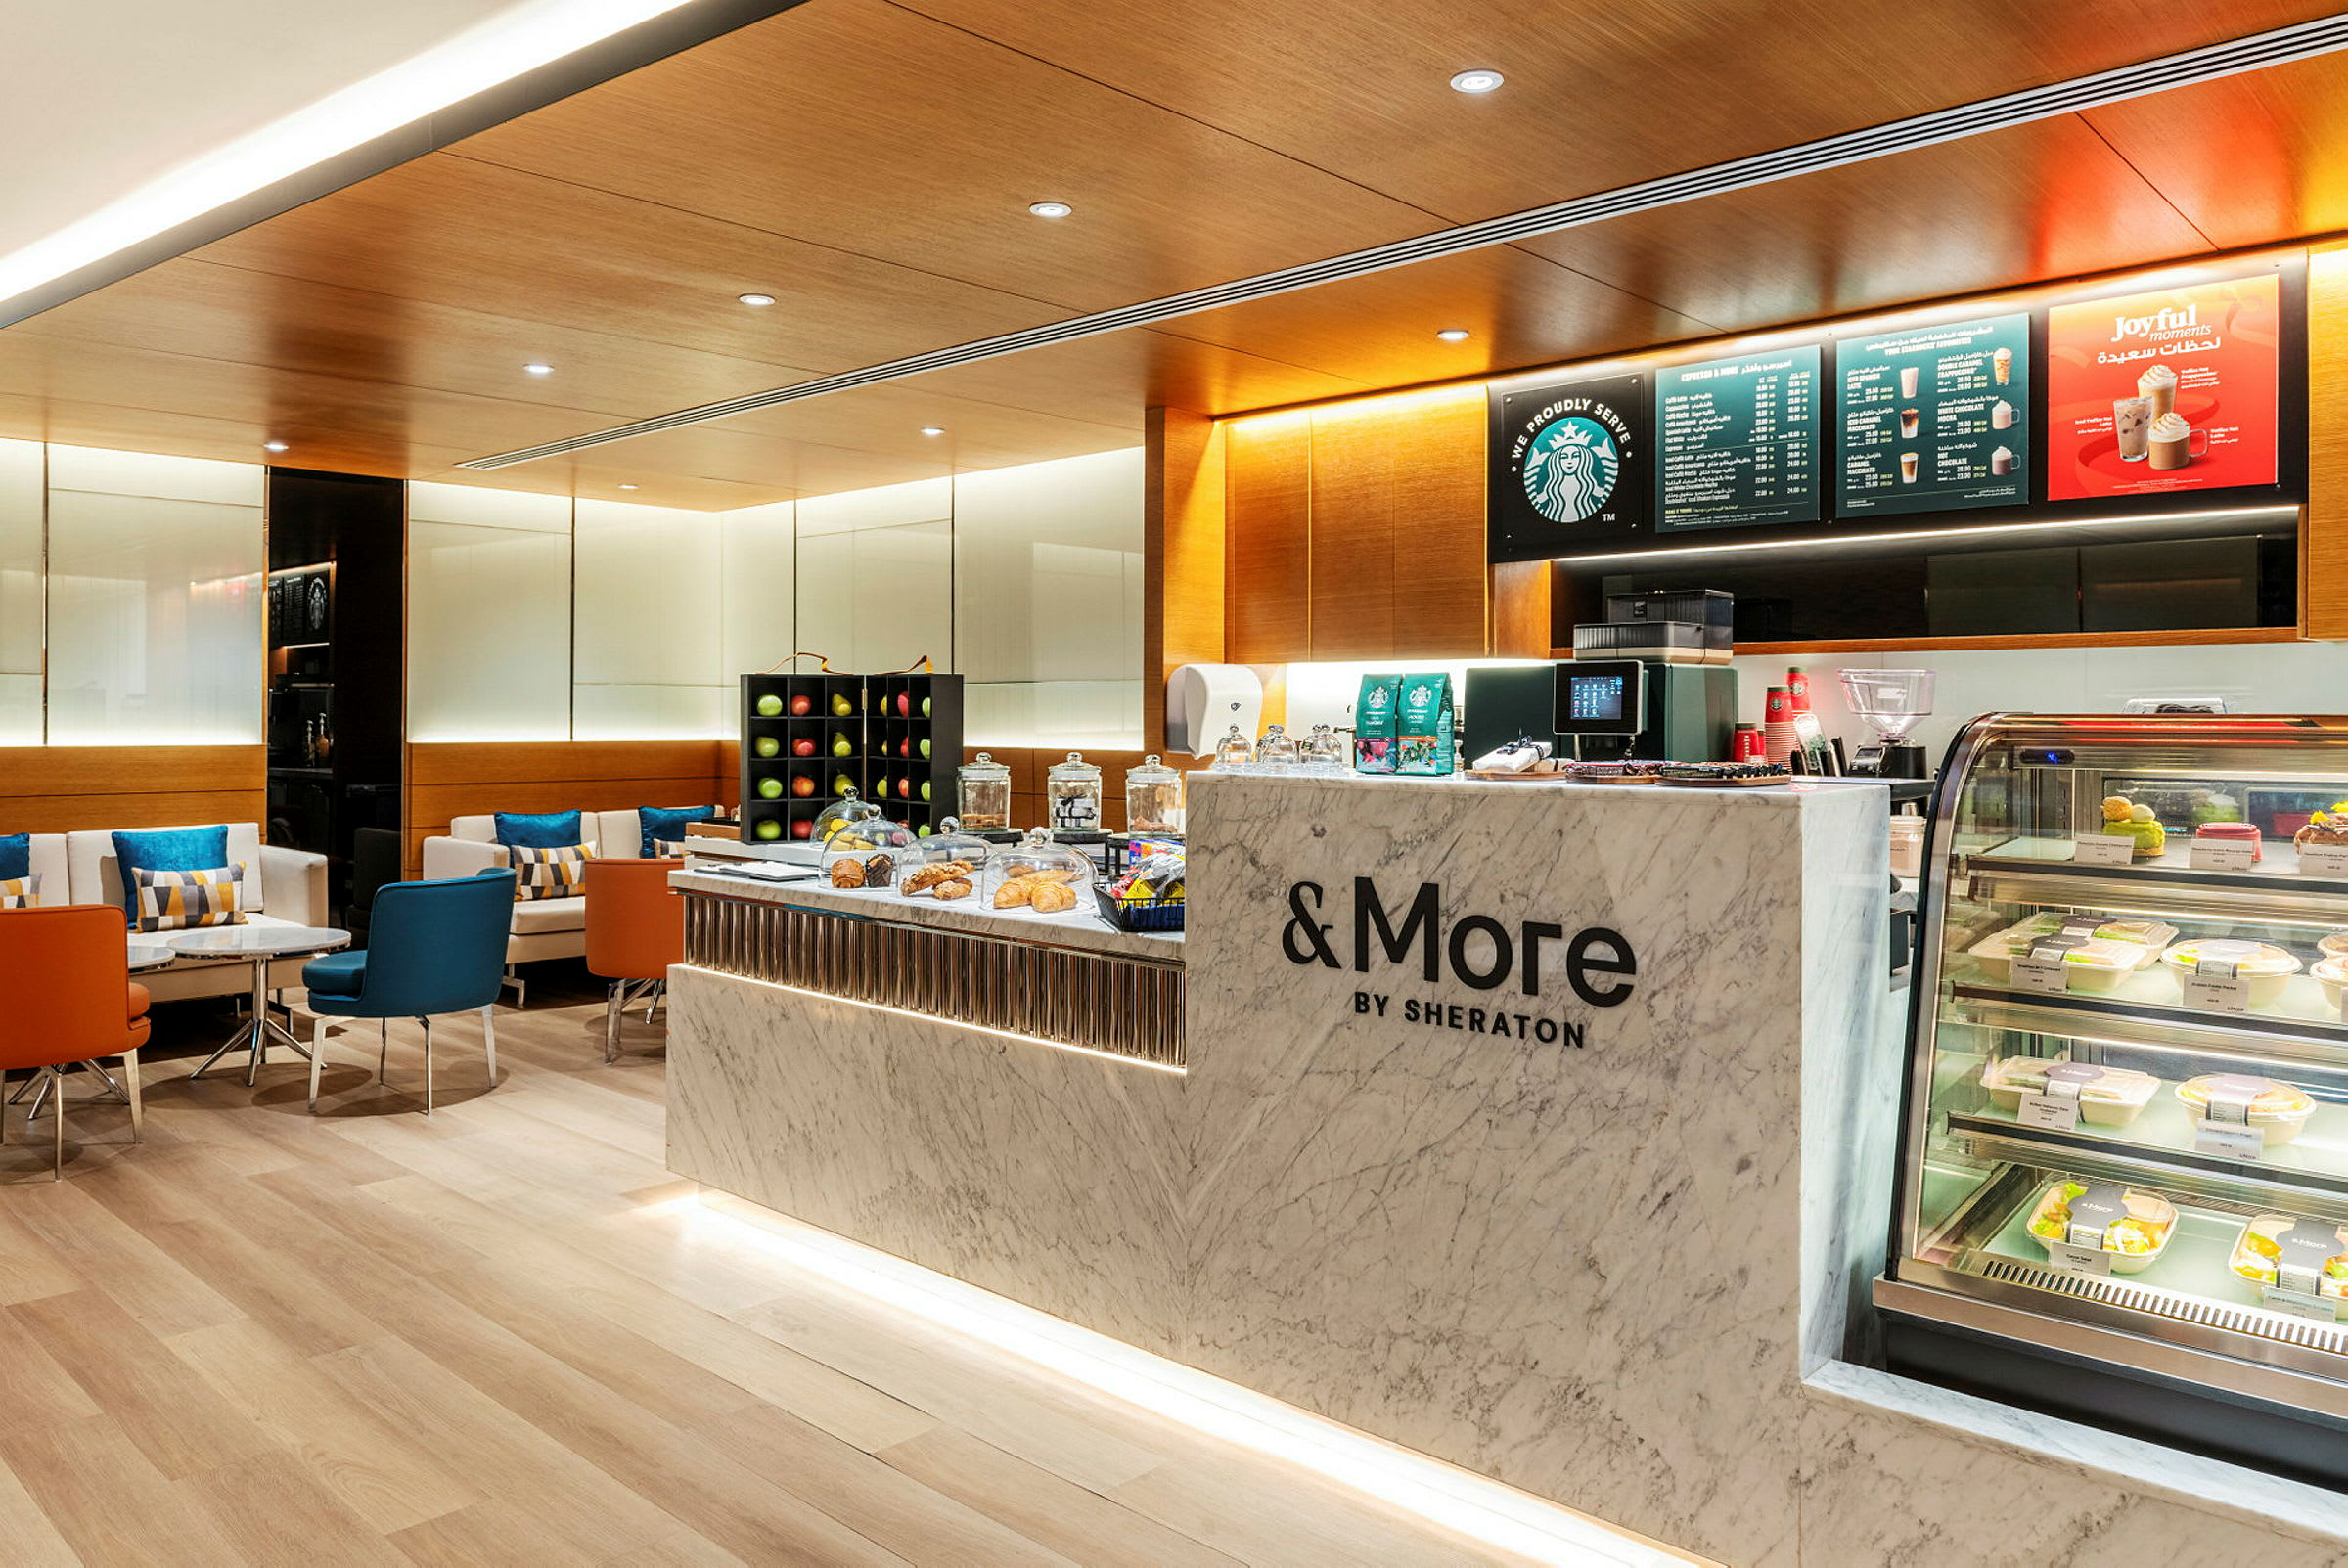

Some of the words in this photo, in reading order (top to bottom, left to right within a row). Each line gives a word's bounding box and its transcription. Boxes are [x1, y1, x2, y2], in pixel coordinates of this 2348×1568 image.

[2110, 303, 2197, 342] Joyful
[2149, 324, 2212, 342] moments
[2097, 347, 2156, 364] سعيدة
[2159, 336, 2221, 357] لحظات
[1955, 403, 1984, 413] CHOCOLATE
[1512, 434, 1529, 460] WE
[1526, 398, 1593, 433] PROUDLY
[1594, 403, 1632, 445] SERVE
[1938, 458, 1967, 467] CHOCOLATE
[1602, 513, 1616, 522] TM
[1354, 991, 1389, 1017] BY
[1404, 999, 1584, 1049] SHERATON
